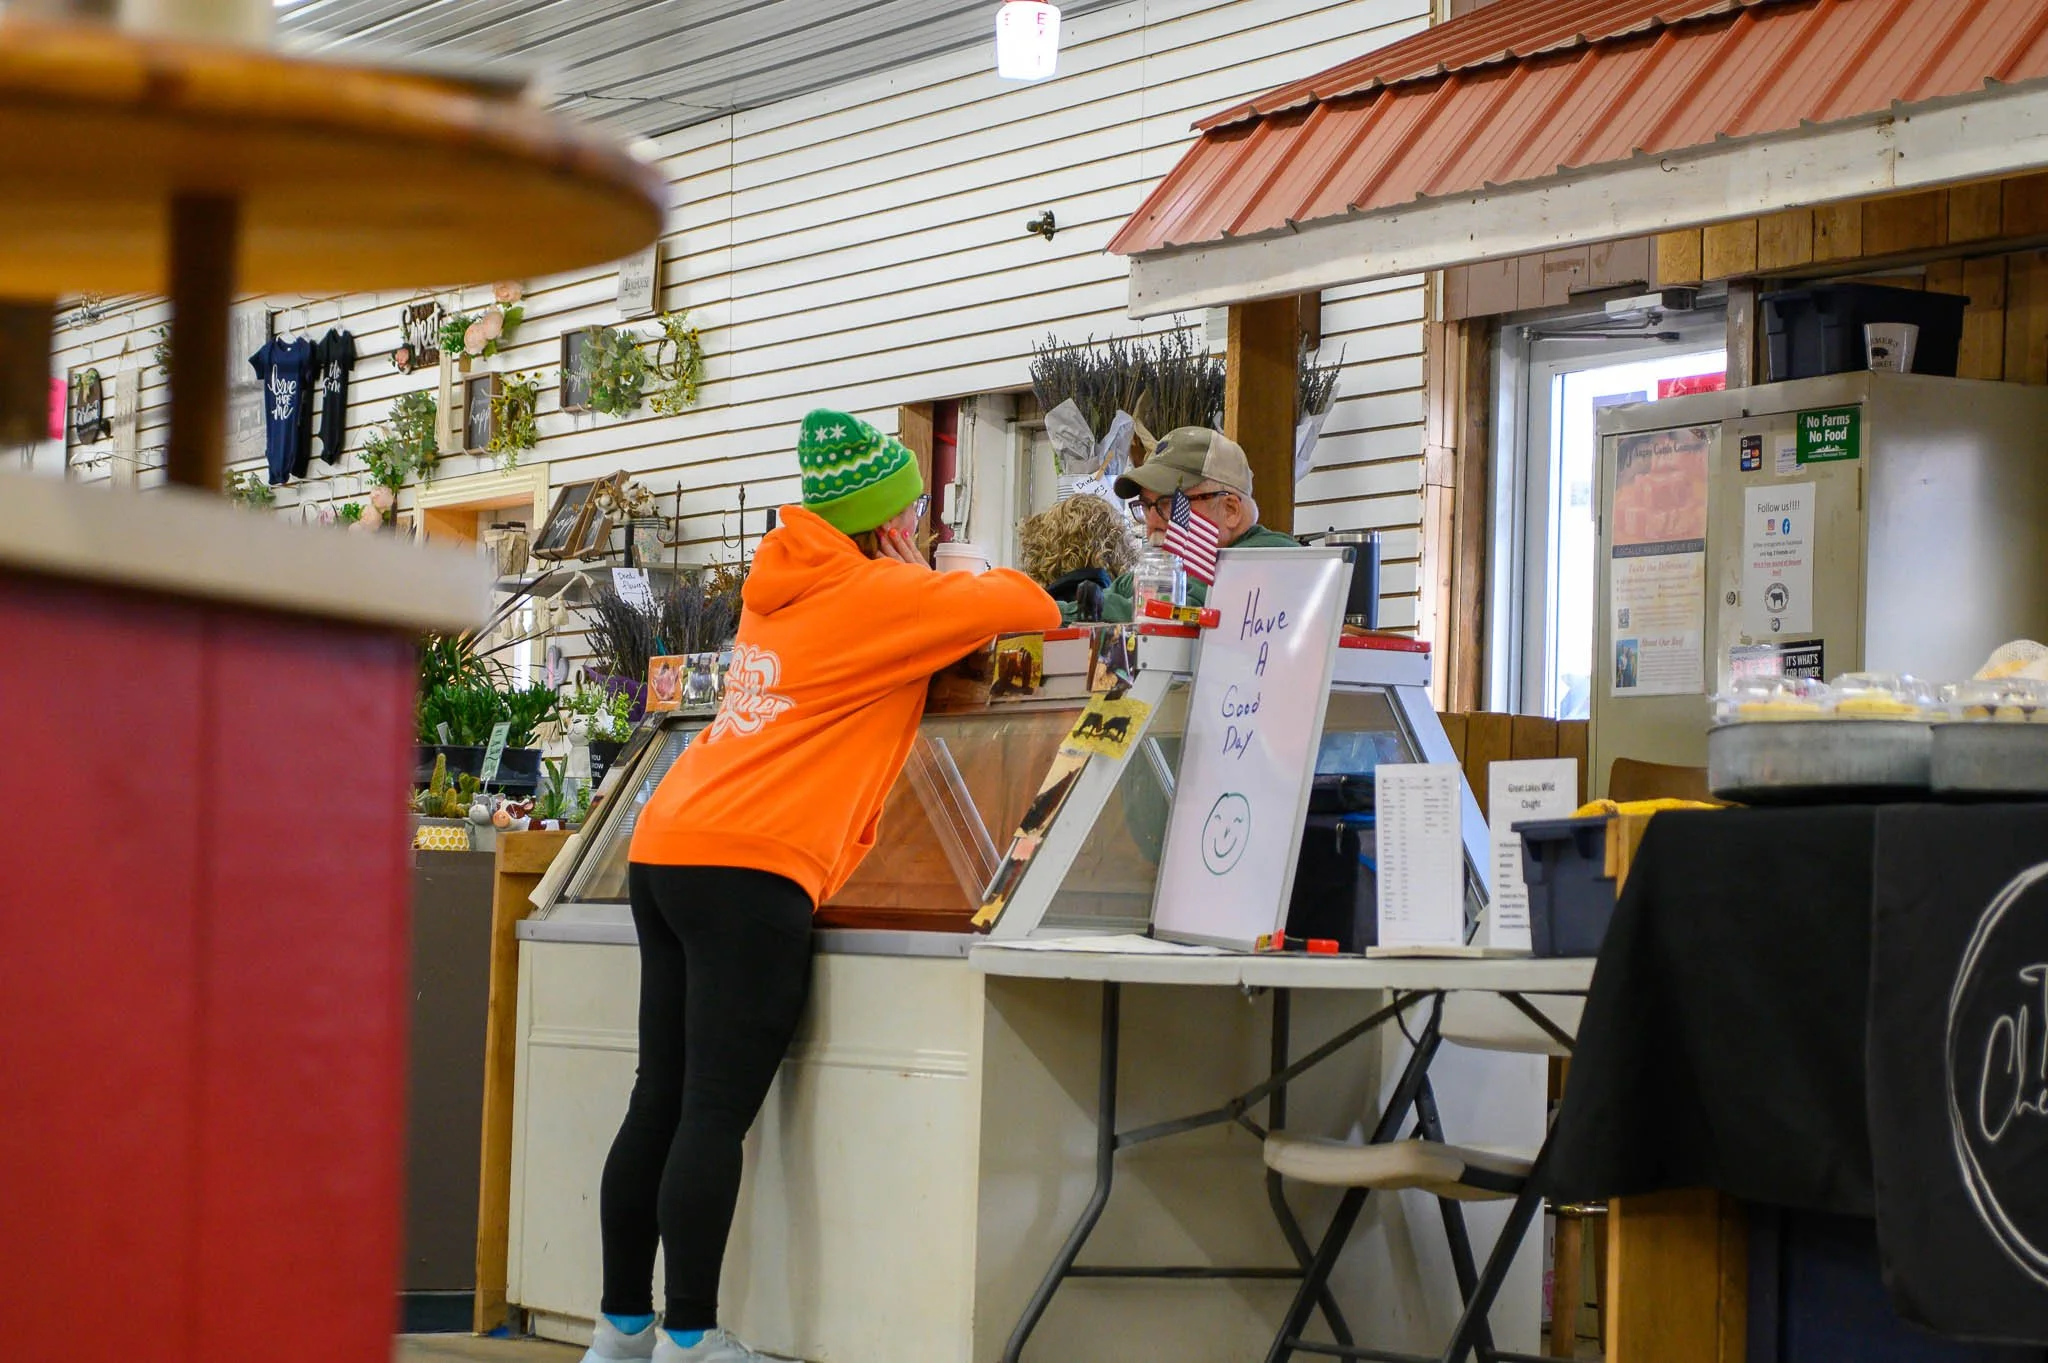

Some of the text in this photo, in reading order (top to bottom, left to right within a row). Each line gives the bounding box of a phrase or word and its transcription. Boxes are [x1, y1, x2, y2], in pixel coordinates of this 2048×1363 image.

[402, 302, 441, 357] Sweet
[267, 364, 297, 395] love
[1806, 414, 1851, 428] No Farms
[1809, 426, 1847, 443] No Food
[1076, 476, 1098, 490] Dried
[1757, 500, 1800, 513] Follow us!!!!
[1240, 587, 1288, 640] Have
[1255, 641, 1269, 676] A
[1785, 653, 1819, 667] IT'S WHAT'S
[1785, 668, 1798, 679] FOR
[1221, 685, 1261, 718] Good
[1222, 725, 1253, 760] Day
[1508, 782, 1556, 793] Great Lakes Wild
[1521, 799, 1541, 810] Caught
